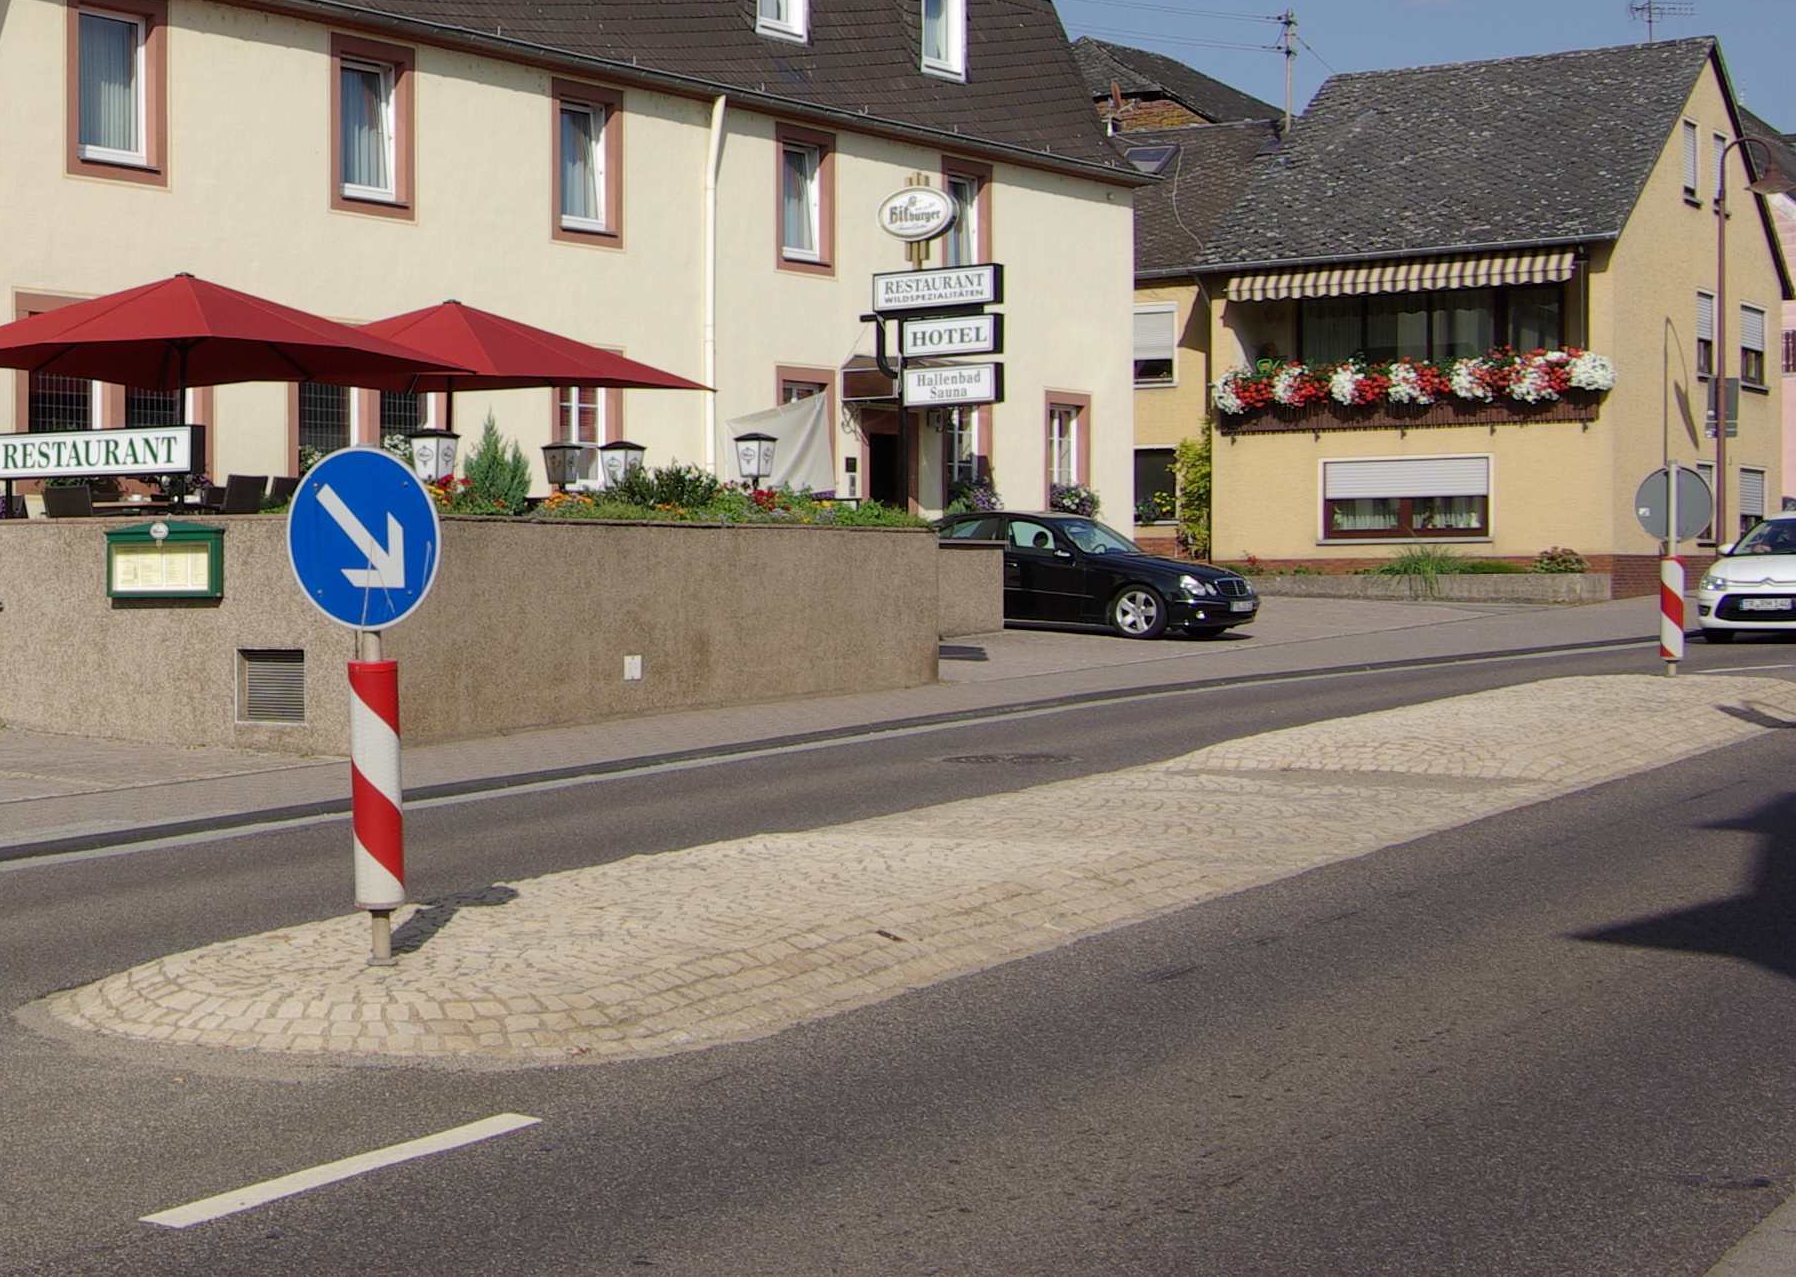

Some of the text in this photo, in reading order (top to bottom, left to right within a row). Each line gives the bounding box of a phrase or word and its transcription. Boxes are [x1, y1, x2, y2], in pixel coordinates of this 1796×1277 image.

[884, 273, 984, 295] RESTAURANT
[884, 289, 983, 304] WILDSPEZIALITÄTEN
[911, 326, 988, 347] HOTEL
[917, 370, 981, 387] Hallenbad
[930, 386, 968, 399] Sauna
[2, 436, 178, 470] RESTAURANT
